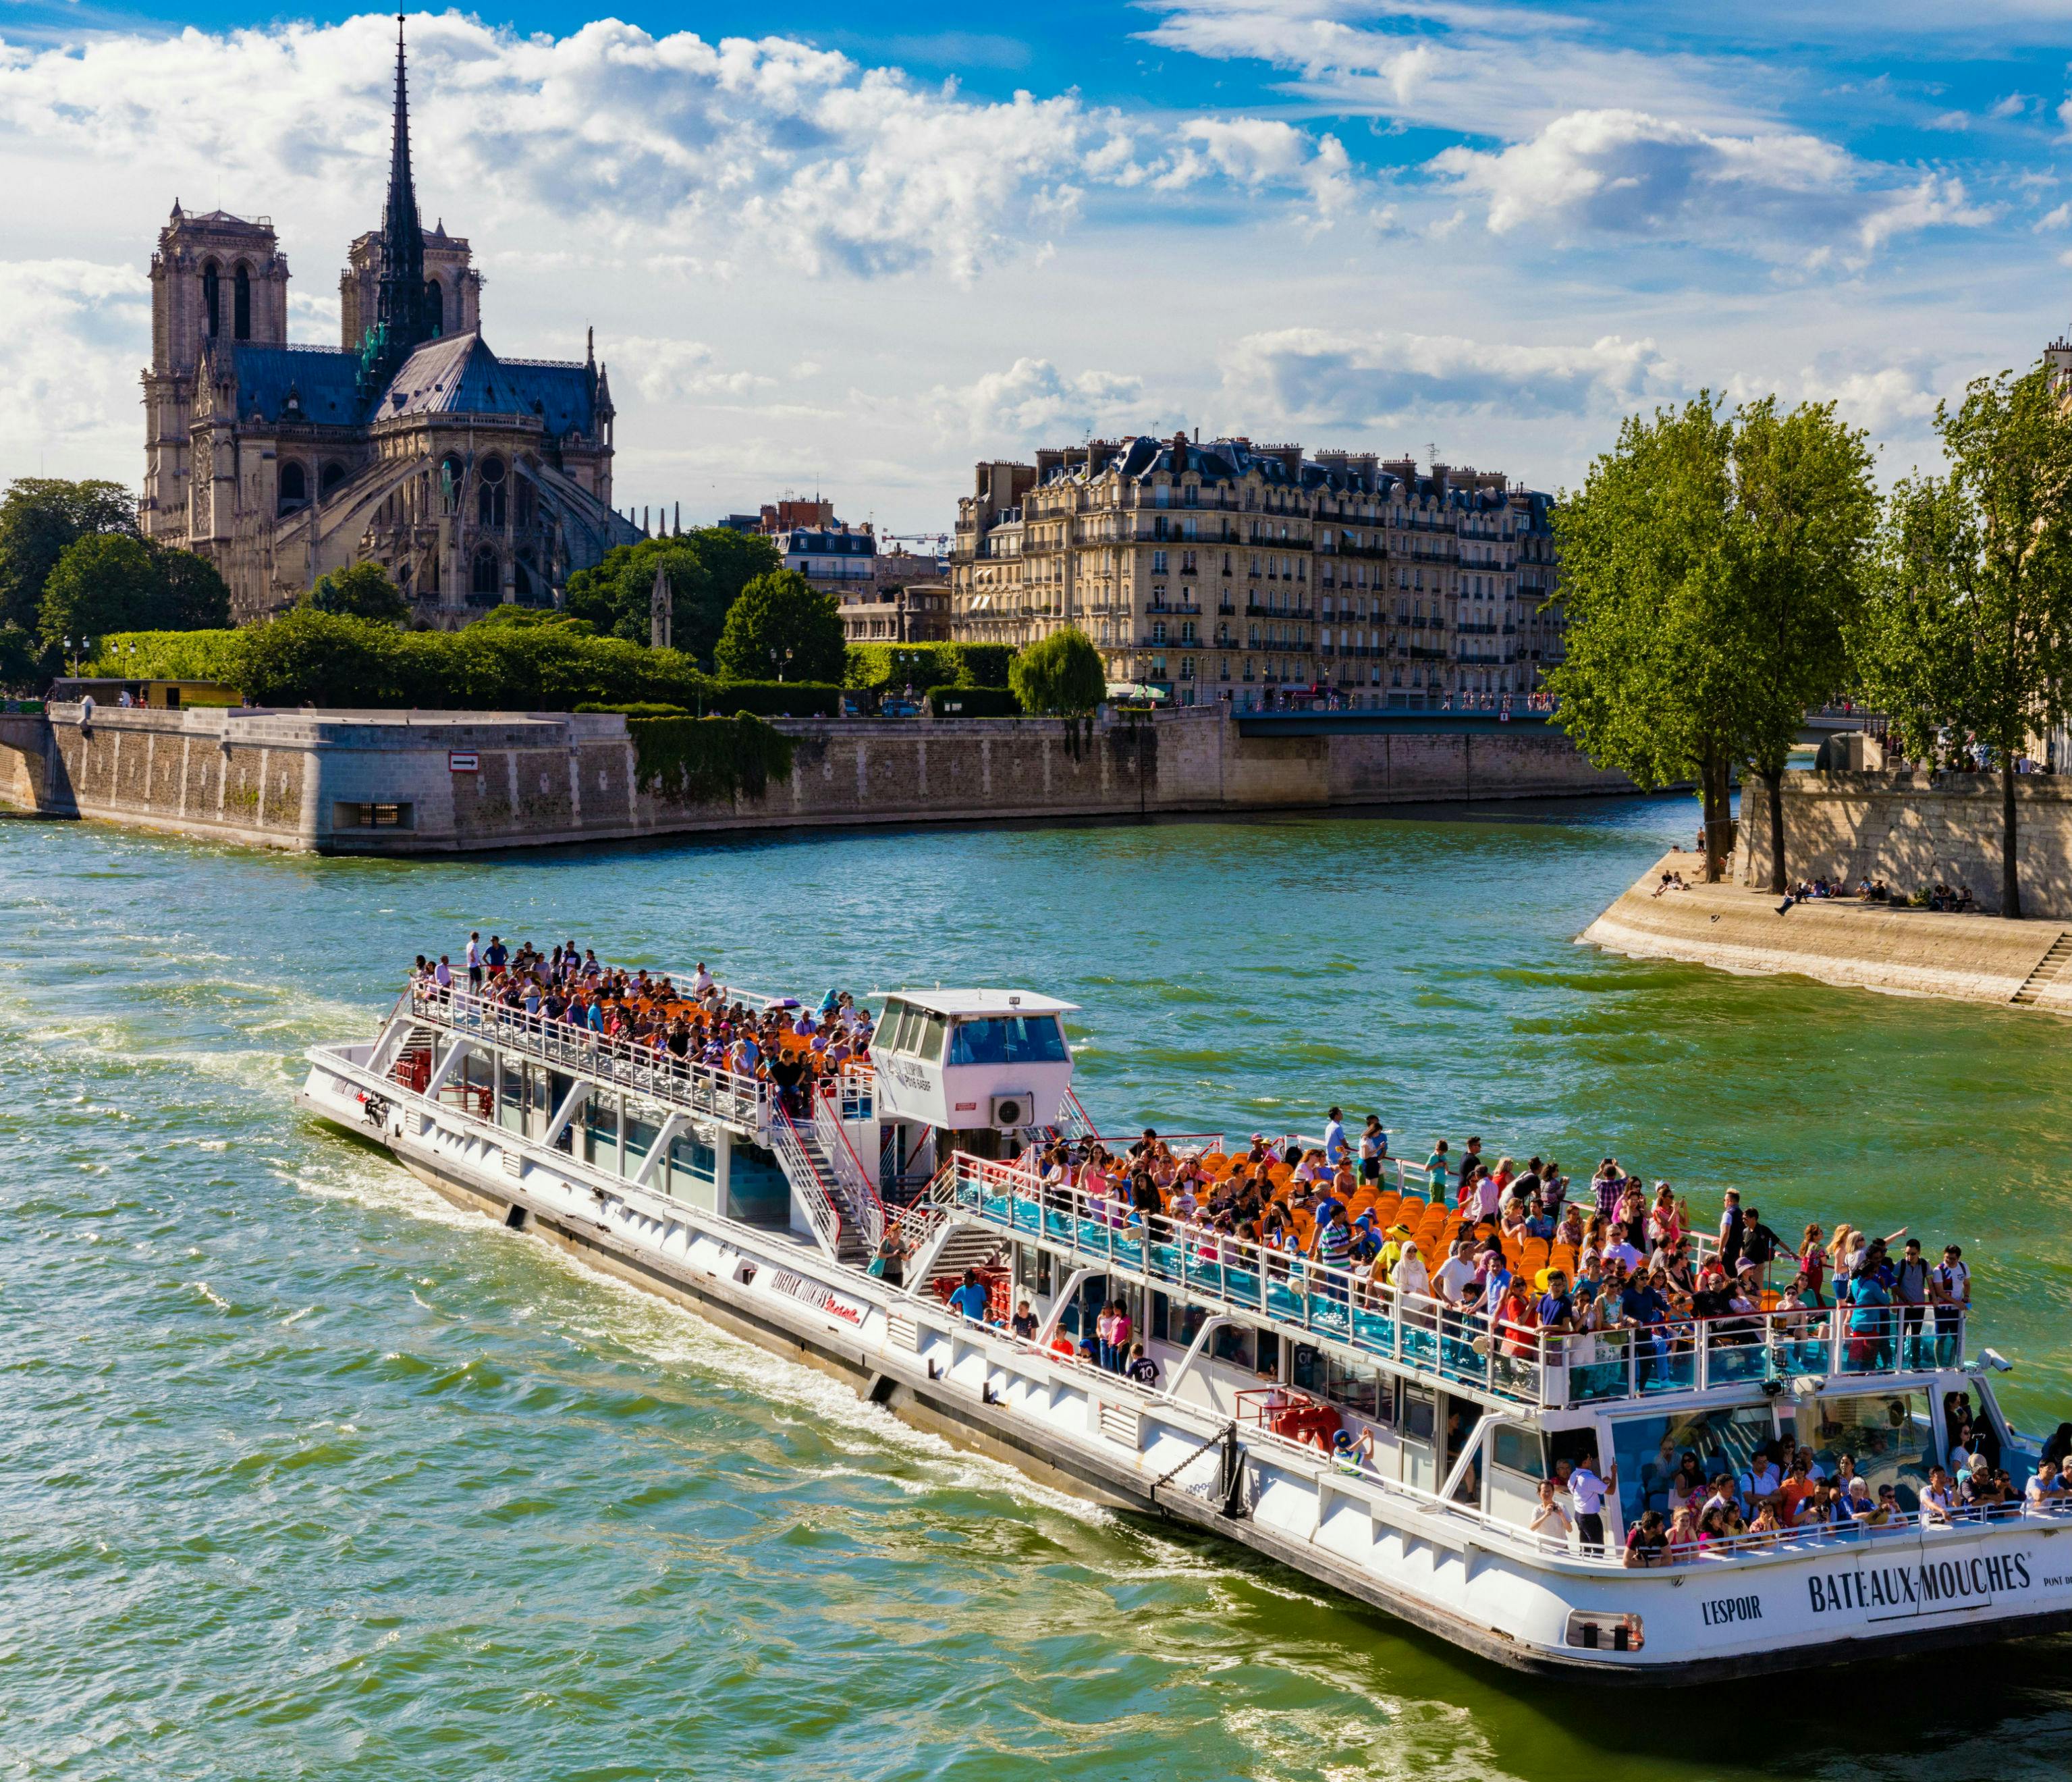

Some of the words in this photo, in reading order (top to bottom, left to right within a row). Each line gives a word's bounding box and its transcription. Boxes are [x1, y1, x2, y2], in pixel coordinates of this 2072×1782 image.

[1140, 1366, 1153, 1379] 10
[2044, 1577, 2063, 1586] PONT
[1702, 1596, 1762, 1625] L'ESPOIR
